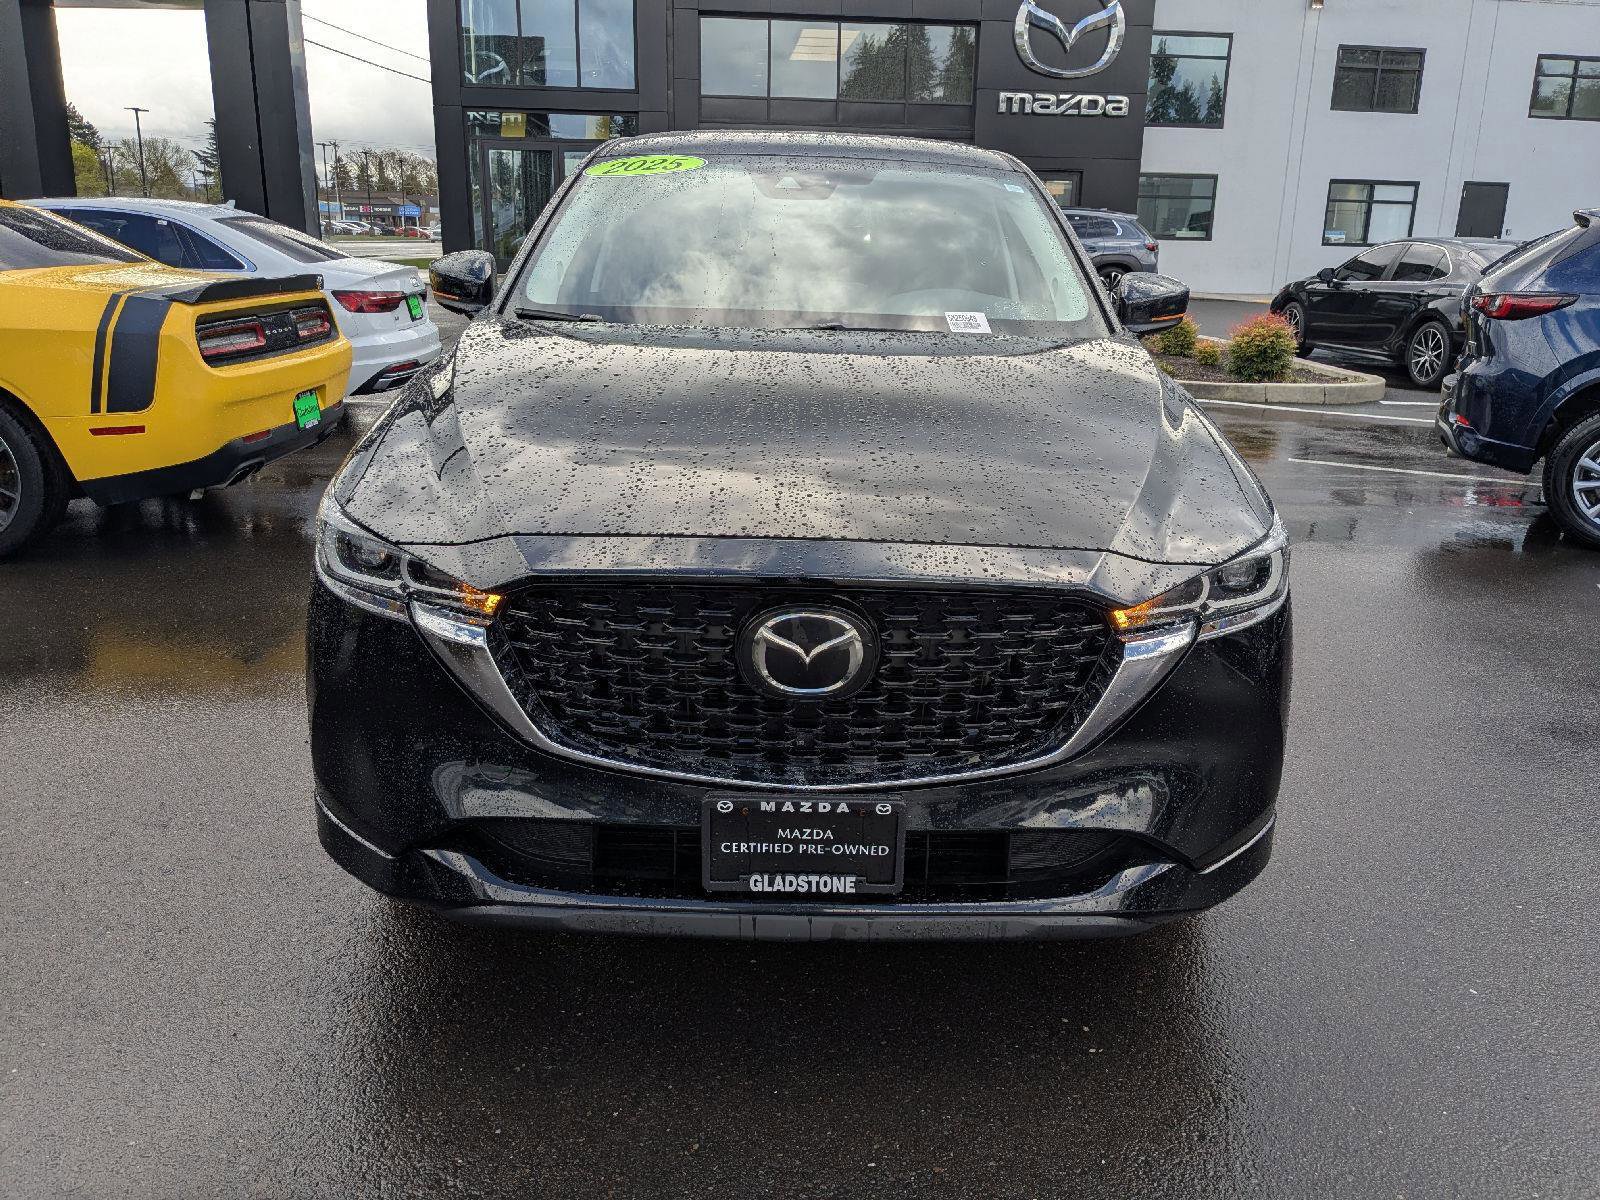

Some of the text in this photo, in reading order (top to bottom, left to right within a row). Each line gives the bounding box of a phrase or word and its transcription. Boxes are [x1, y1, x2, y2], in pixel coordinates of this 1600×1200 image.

[601, 158, 690, 175] 2025
[760, 801, 850, 813] MAZDA
[777, 828, 834, 840] MAZDA
[720, 842, 890, 856] CERTIFIED PRE-OWNED
[749, 874, 856, 893] GLADSTONE
